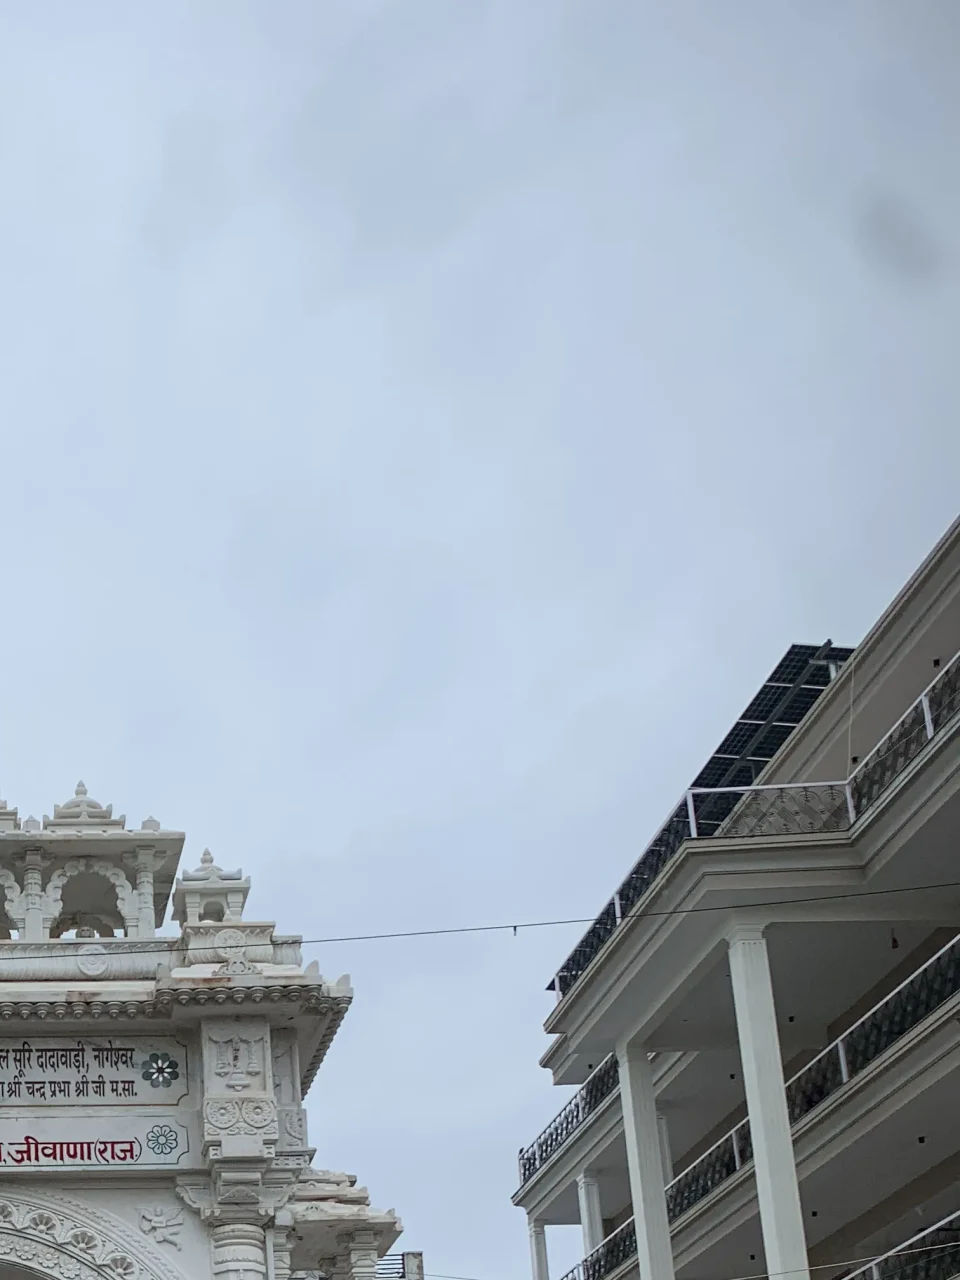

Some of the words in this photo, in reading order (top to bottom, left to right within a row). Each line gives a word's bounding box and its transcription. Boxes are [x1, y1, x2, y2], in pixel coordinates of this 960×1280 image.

[12, 1041, 34, 1078] सूरि
[35, 1041, 89, 1074] दादावाड़ी,
[92, 1040, 135, 1069] नागेश्वर
[7, 1075, 21, 1098] श्री
[25, 1081, 47, 1100] चन्द्र
[49, 1081, 71, 1097] प्रभा
[75, 1075, 89, 1098] श्री
[91, 1075, 106, 1097] जी
[109, 1080, 137, 1097] म.सा.
[7, 1136, 94, 1164] जीवाणा
